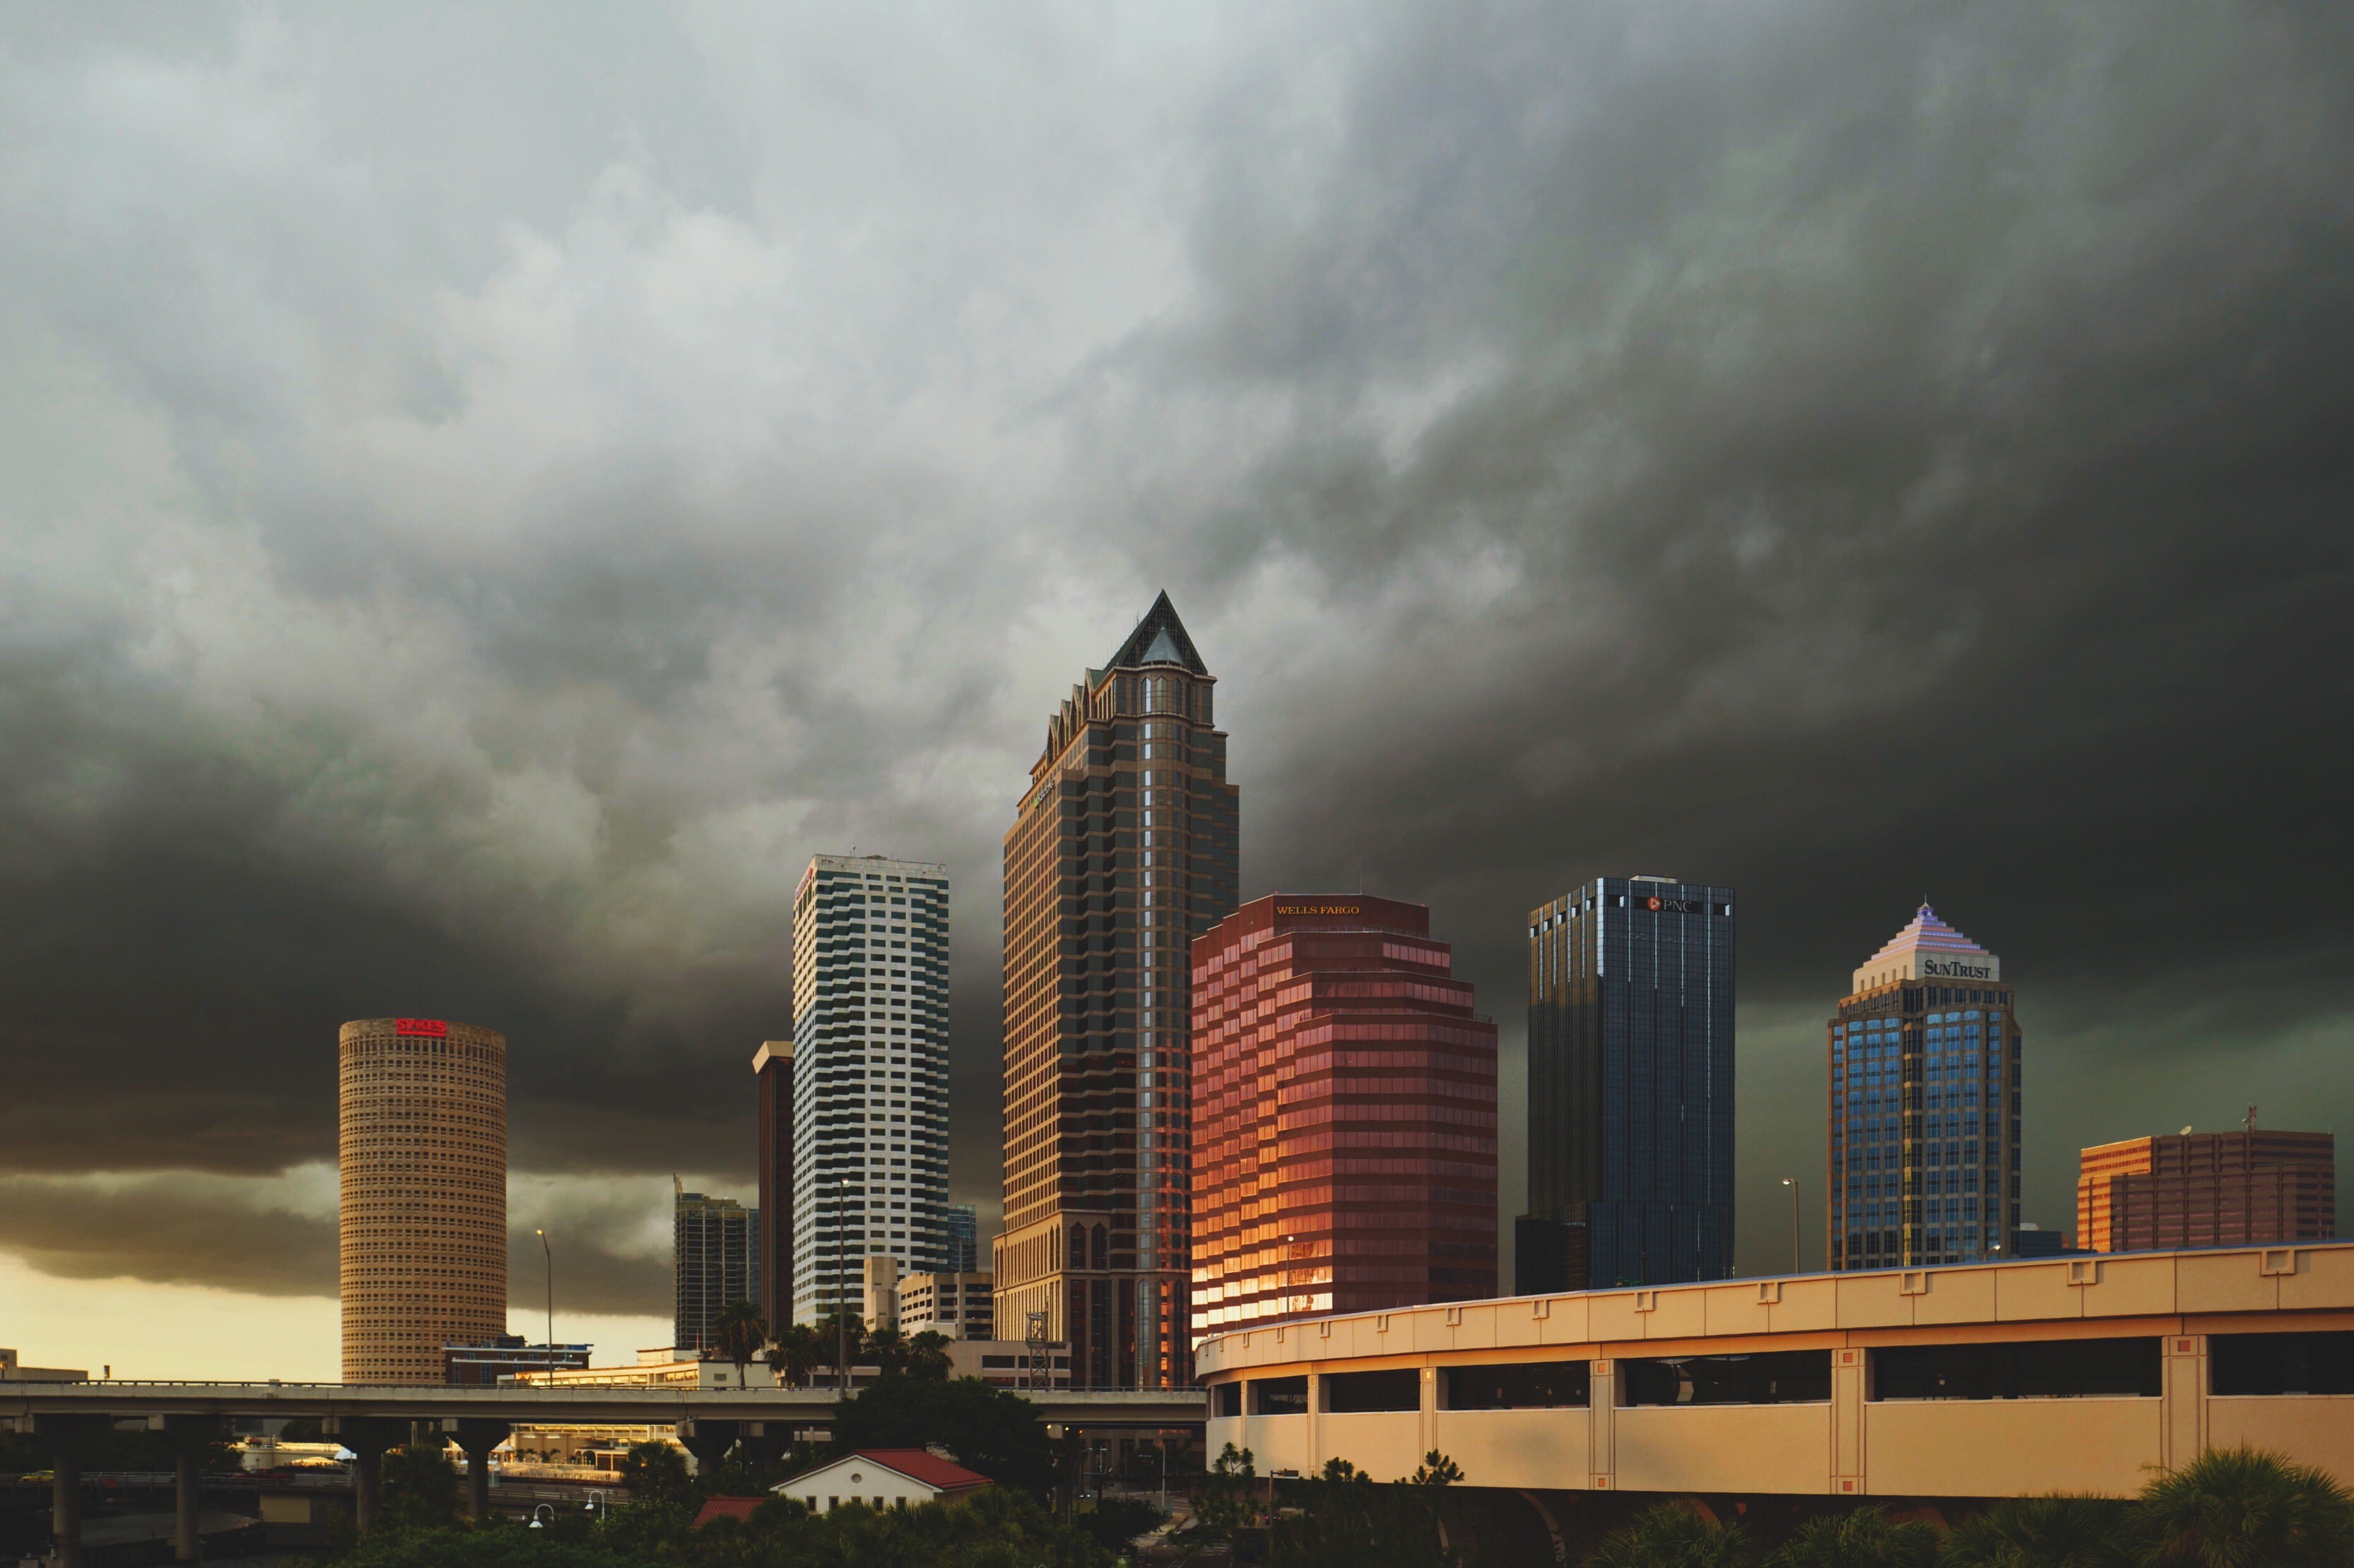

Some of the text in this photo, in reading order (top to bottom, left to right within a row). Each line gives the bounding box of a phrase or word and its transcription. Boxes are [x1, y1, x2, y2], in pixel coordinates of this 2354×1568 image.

[1277, 906, 1359, 914] WELLS FARGO
[1664, 899, 1691, 912] PNC
[396, 1018, 446, 1032] SYKES
